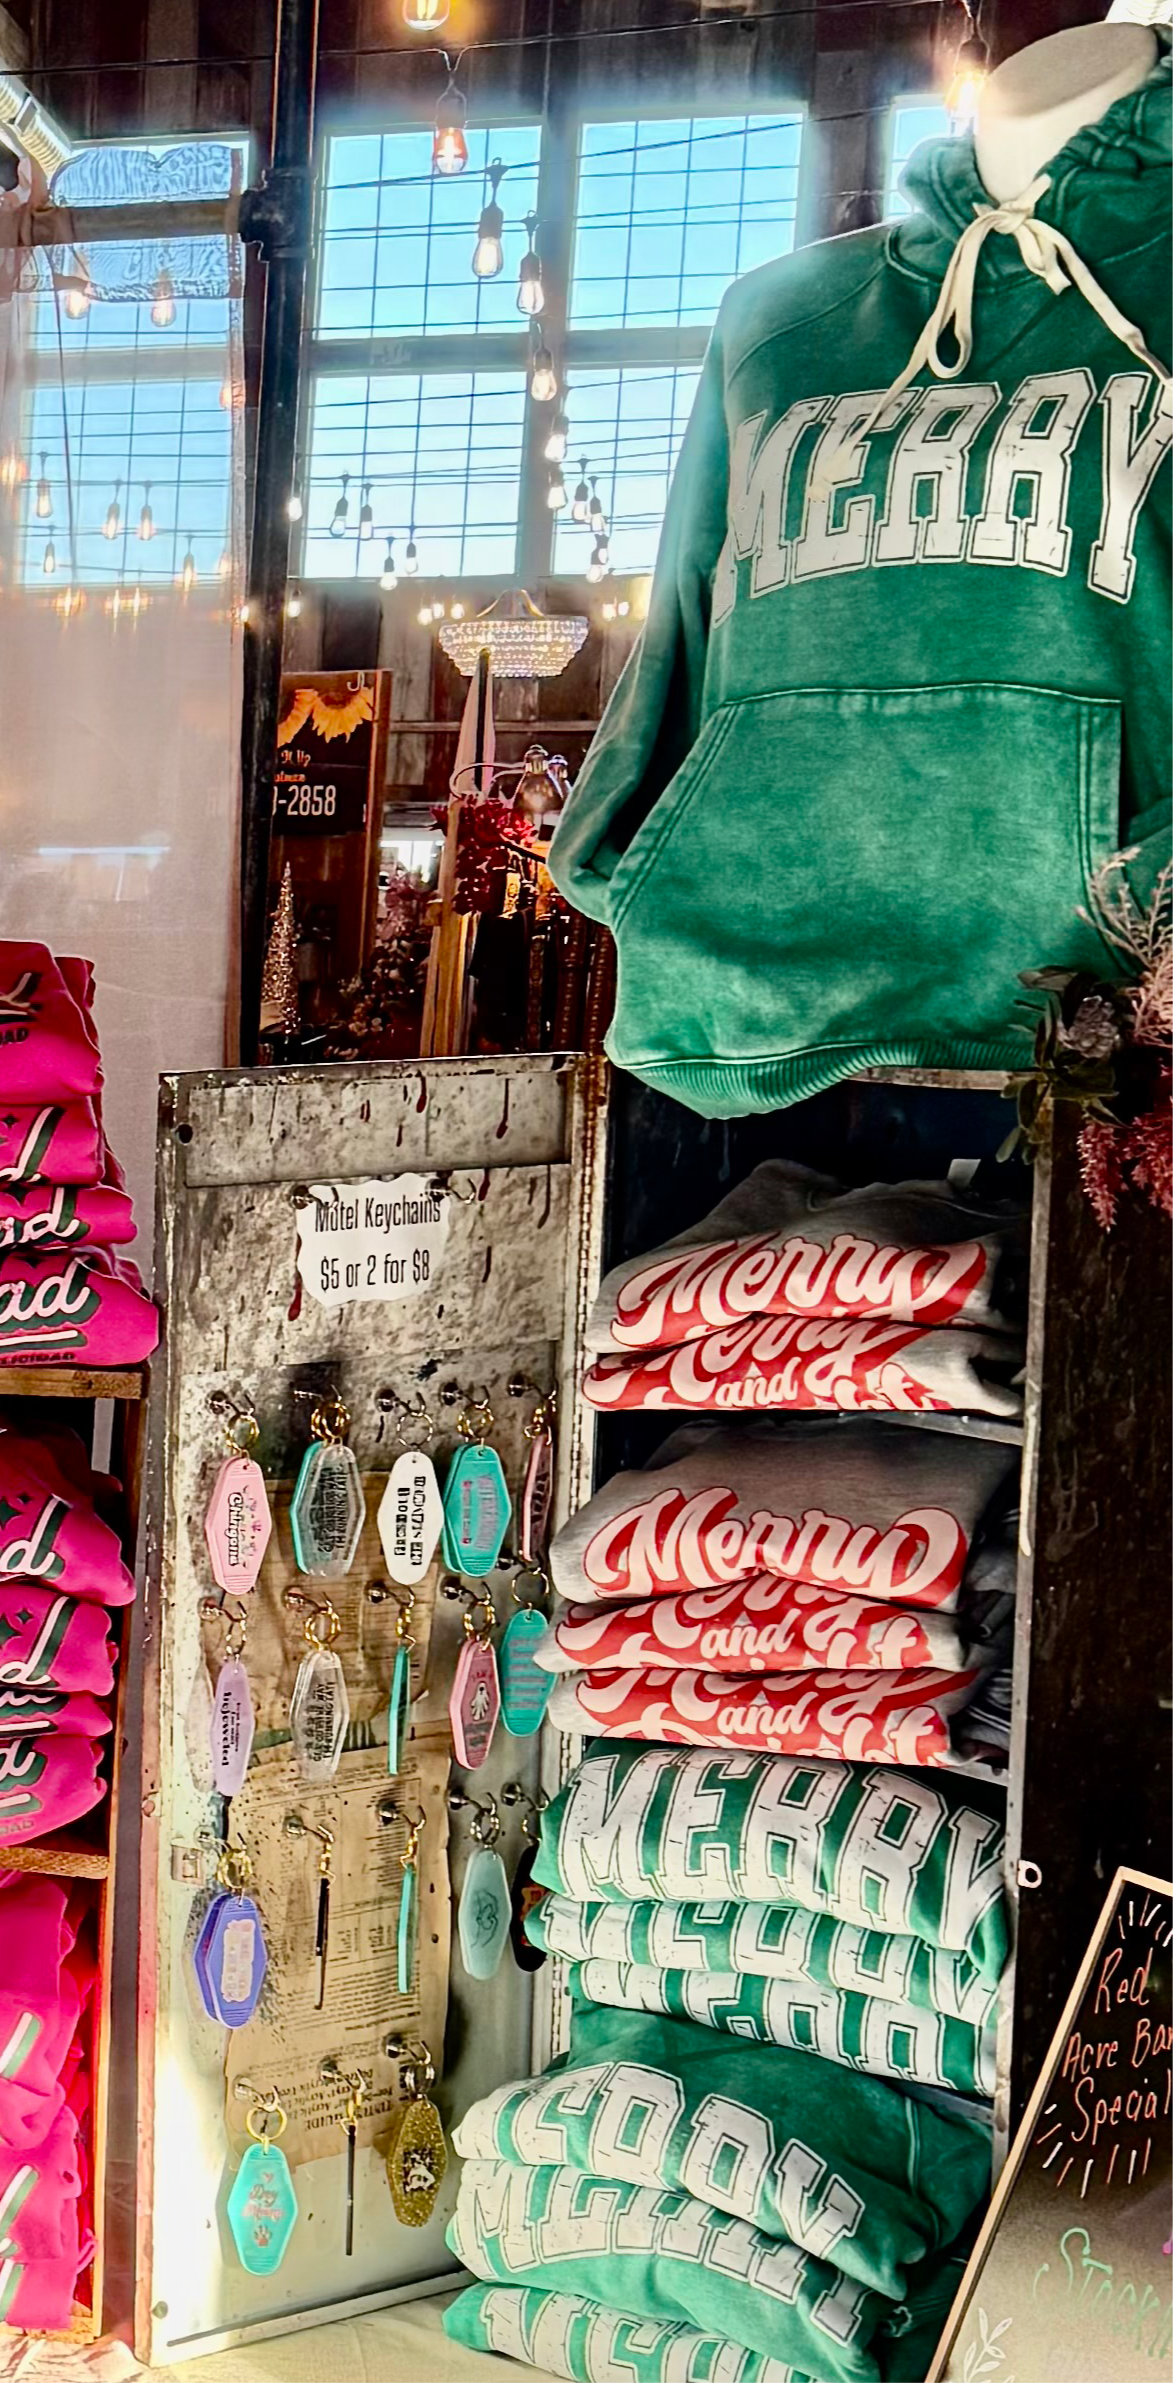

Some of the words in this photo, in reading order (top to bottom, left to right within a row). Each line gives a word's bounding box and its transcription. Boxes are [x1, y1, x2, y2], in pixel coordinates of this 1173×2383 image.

[712, 367, 1173, 629] MERRY
[273, 784, 337, 816] -2858
[314, 1197, 360, 1233] Motel
[364, 1191, 442, 1234] Keychains
[320, 1256, 340, 1293] $5
[345, 1262, 362, 1288] or
[366, 1254, 377, 1286] 2
[384, 1252, 407, 1284] for
[412, 1248, 430, 1285] $8
[611, 1231, 987, 1349] Merry
[714, 1356, 802, 1408] and
[583, 1485, 967, 1607] Merry
[700, 1608, 802, 1660] and
[717, 1692, 817, 1736] and
[1094, 1947, 1150, 2014] Red
[1062, 2031, 1119, 2083] Acre
[1071, 2067, 1172, 2146] Special
